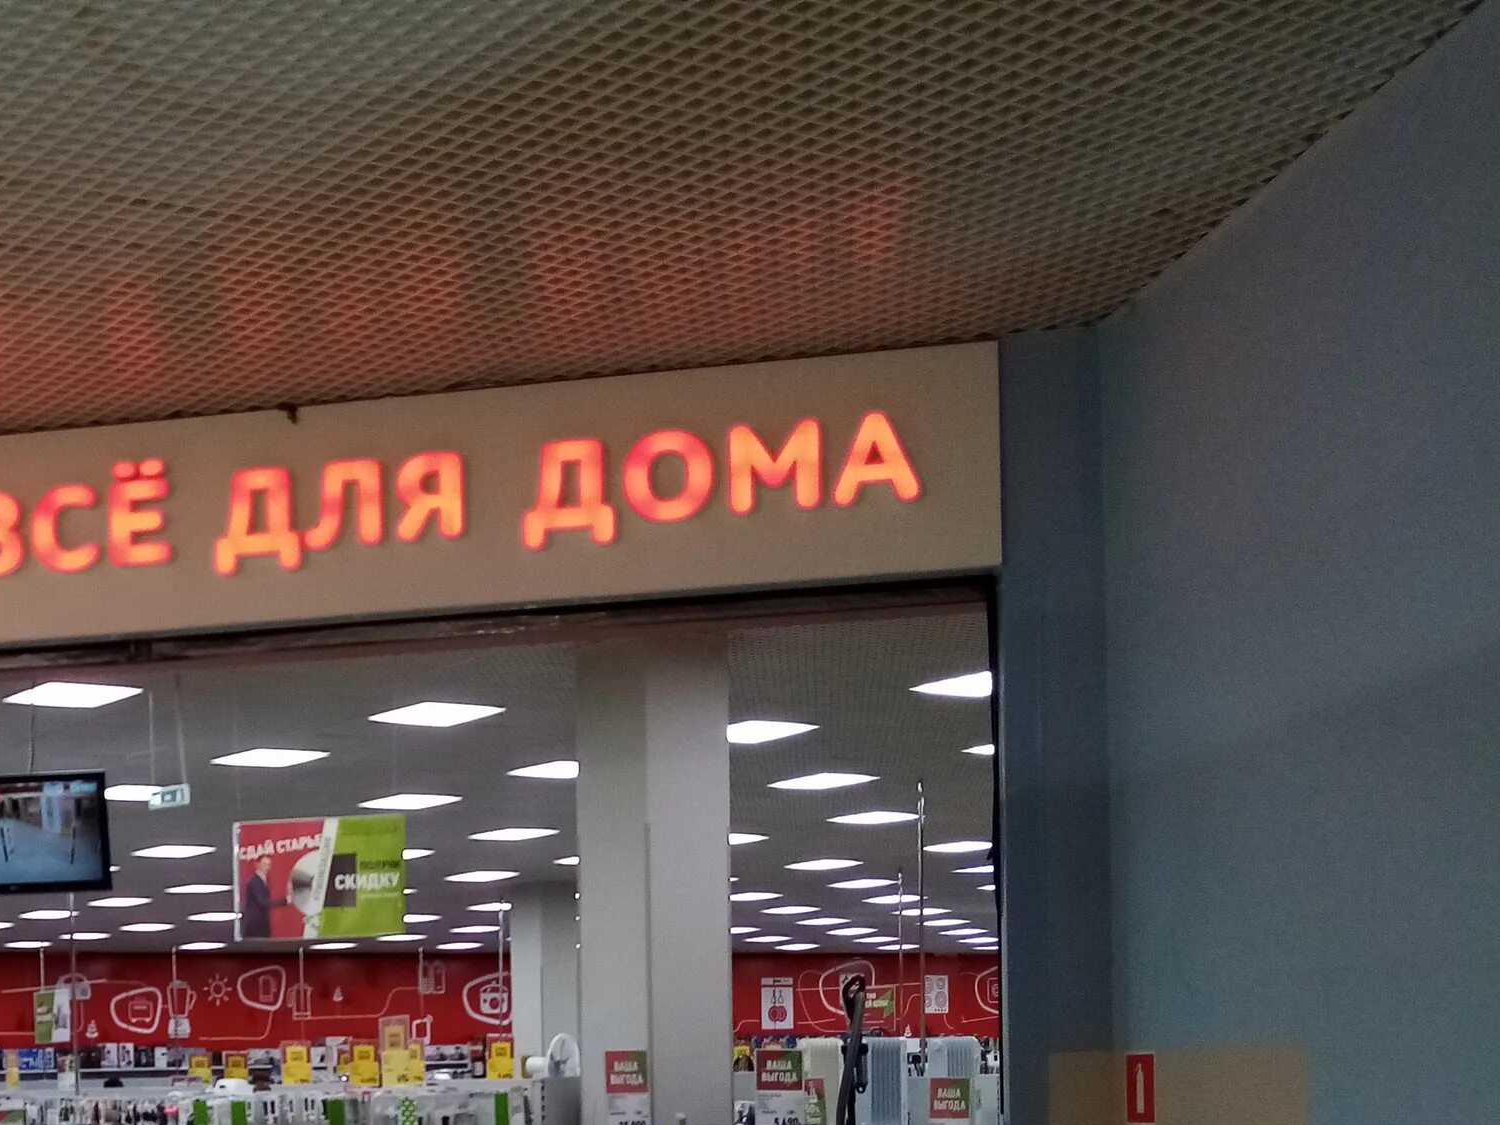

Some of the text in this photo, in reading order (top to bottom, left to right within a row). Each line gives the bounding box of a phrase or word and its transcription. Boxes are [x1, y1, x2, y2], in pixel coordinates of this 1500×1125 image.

[214, 450, 466, 576] ДЛЯ
[522, 411, 921, 552] ДОМА
[334, 872, 400, 890] СКИДКУ
[766, 1060, 792, 1071] ВАША
[761, 1072, 798, 1085] ВЫГОДА
[937, 1087, 962, 1098] ВАША
[933, 1099, 967, 1112] ВЫГОДА
